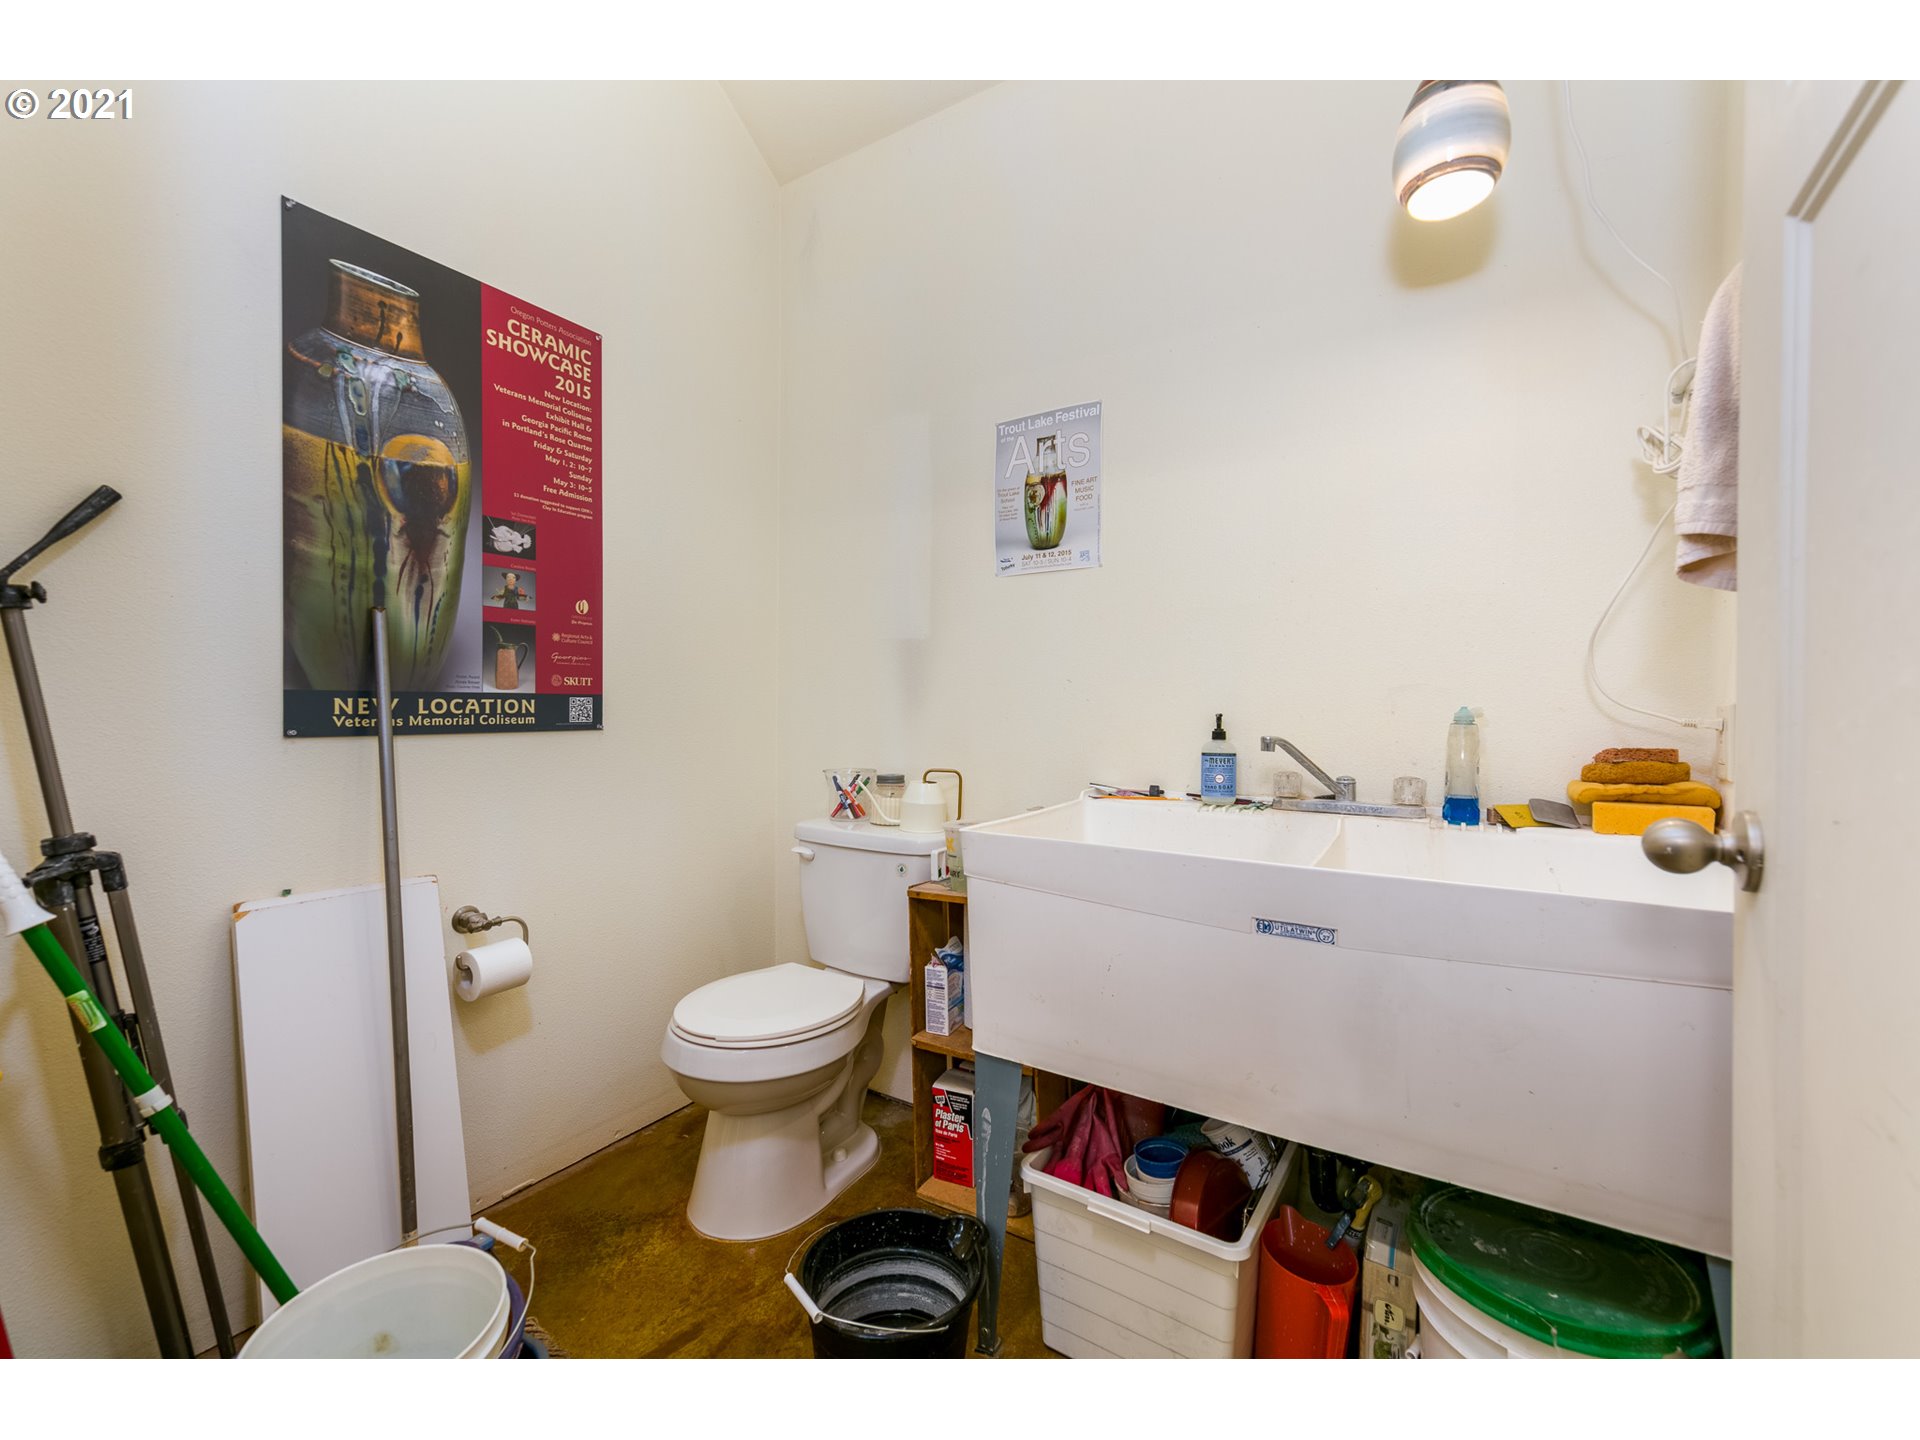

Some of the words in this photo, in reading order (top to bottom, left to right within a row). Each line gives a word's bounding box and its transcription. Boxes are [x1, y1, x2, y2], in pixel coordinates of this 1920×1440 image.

[510, 306, 535, 321] Oregon
[536, 317, 557, 332] Potters
[507, 319, 591, 365] CERAMIC
[486, 328, 591, 382] SHOWCASE
[555, 375, 591, 400] 2015
[494, 383, 526, 401] Veterans
[528, 395, 561, 412] Memorial
[562, 407, 592, 423] Coliseum
[544, 392, 561, 402] New
[562, 397, 592, 413] Location:
[521, 414, 549, 429] Georgia
[550, 423, 572, 437] Pacific
[573, 431, 592, 443] Room
[546, 411, 570, 426] Exhibit
[571, 419, 585, 431] Hall
[998, 422, 1026, 436] Trout
[1028, 416, 1054, 430] Lake
[1055, 404, 1100, 424] Festival
[502, 420, 510, 428] in
[511, 421, 548, 439] Portland's
[550, 434, 566, 444] Rose
[567, 440, 592, 452] Quarter
[533, 440, 555, 454] Friday
[564, 449, 592, 464] Saturday
[545, 454, 560, 466] May
[1004, 429, 1091, 480] Arts
[554, 478, 568, 488] May
[569, 471, 592, 484] Sunday
[1086, 476, 1098, 485] ART
[544, 486, 557, 495] Free
[558, 487, 592, 503] Admission
[1074, 486, 1094, 494] MUSIC
[564, 676, 593, 687] SKUTT
[418, 698, 536, 715] LOCATION
[409, 715, 475, 727] Memorial
[480, 714, 535, 725] Coliseum
[935, 1108, 964, 1124] Plaster
[942, 1119, 964, 1133] Paris
